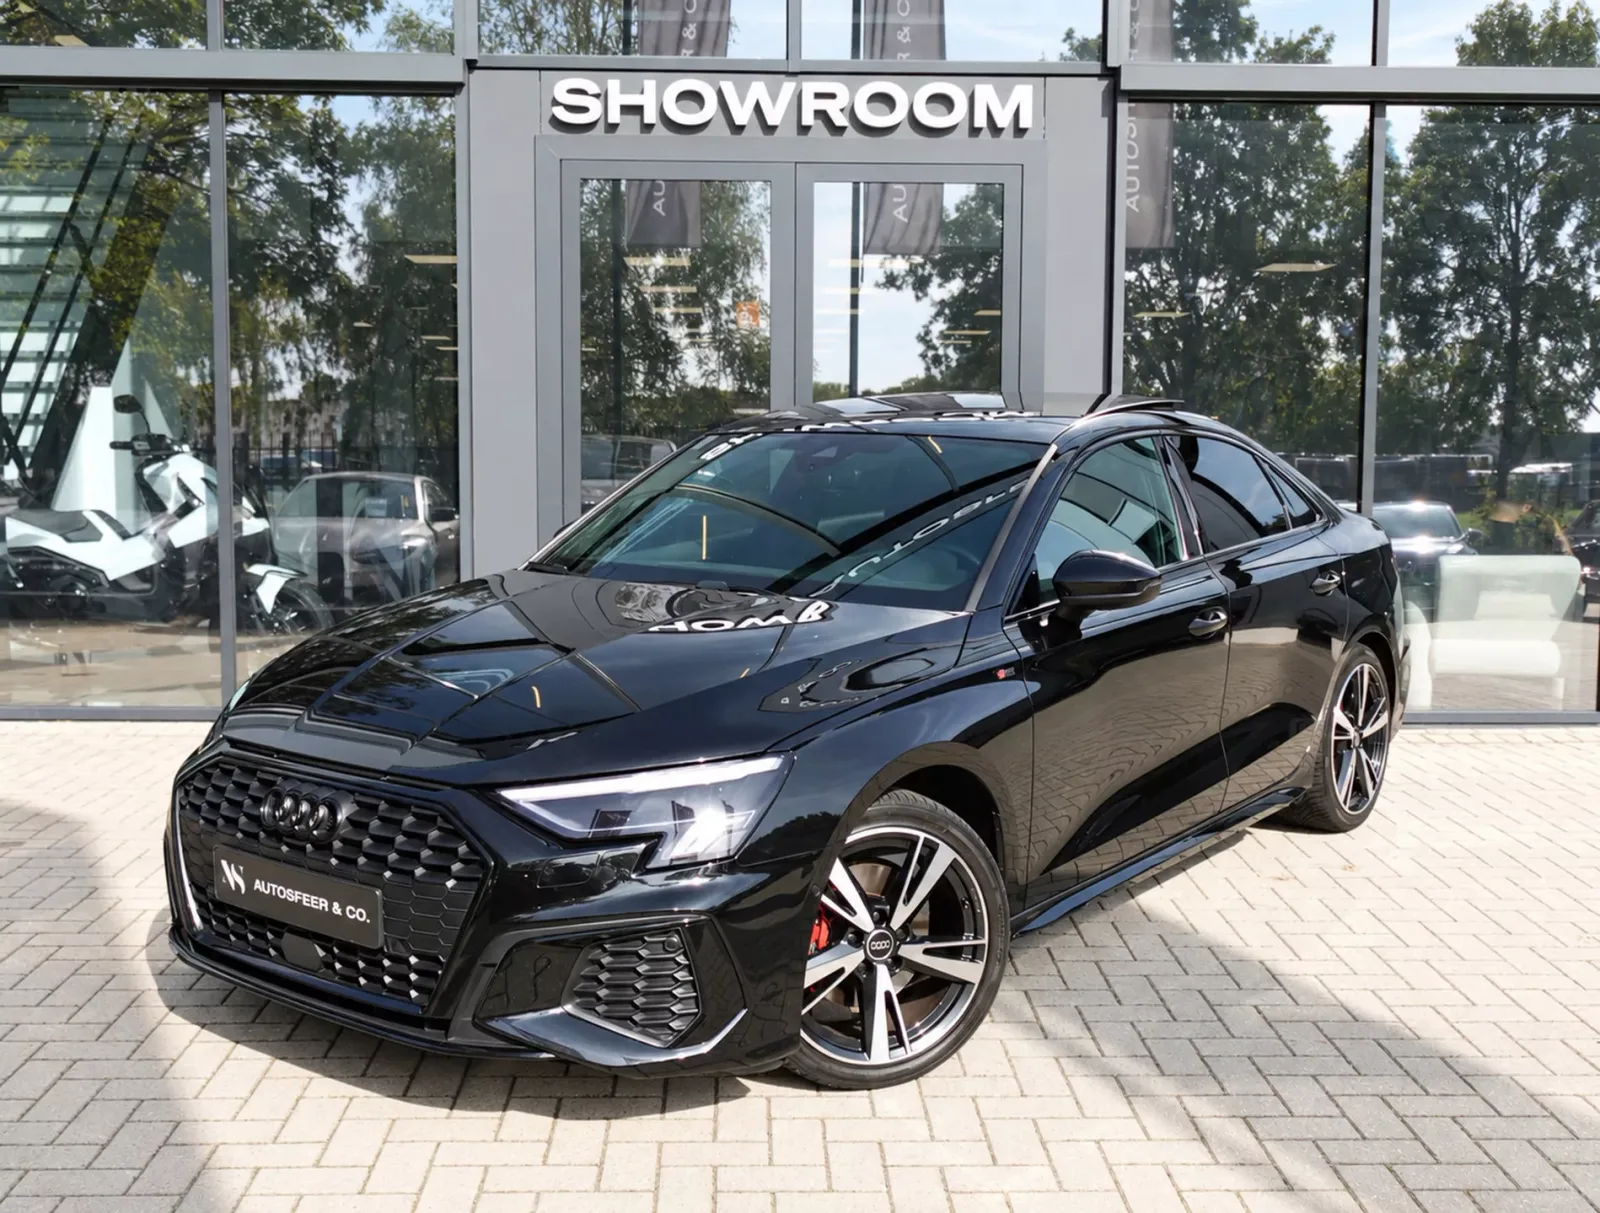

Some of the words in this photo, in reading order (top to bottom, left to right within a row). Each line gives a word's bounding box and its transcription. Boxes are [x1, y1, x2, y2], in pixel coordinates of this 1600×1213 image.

[681, 23, 697, 40] &
[896, 26, 911, 43] &
[550, 77, 1034, 132] SHOWROOM
[253, 878, 329, 912] AUTOSFEER
[331, 901, 343, 917] &
[345, 905, 371, 924] CO.
